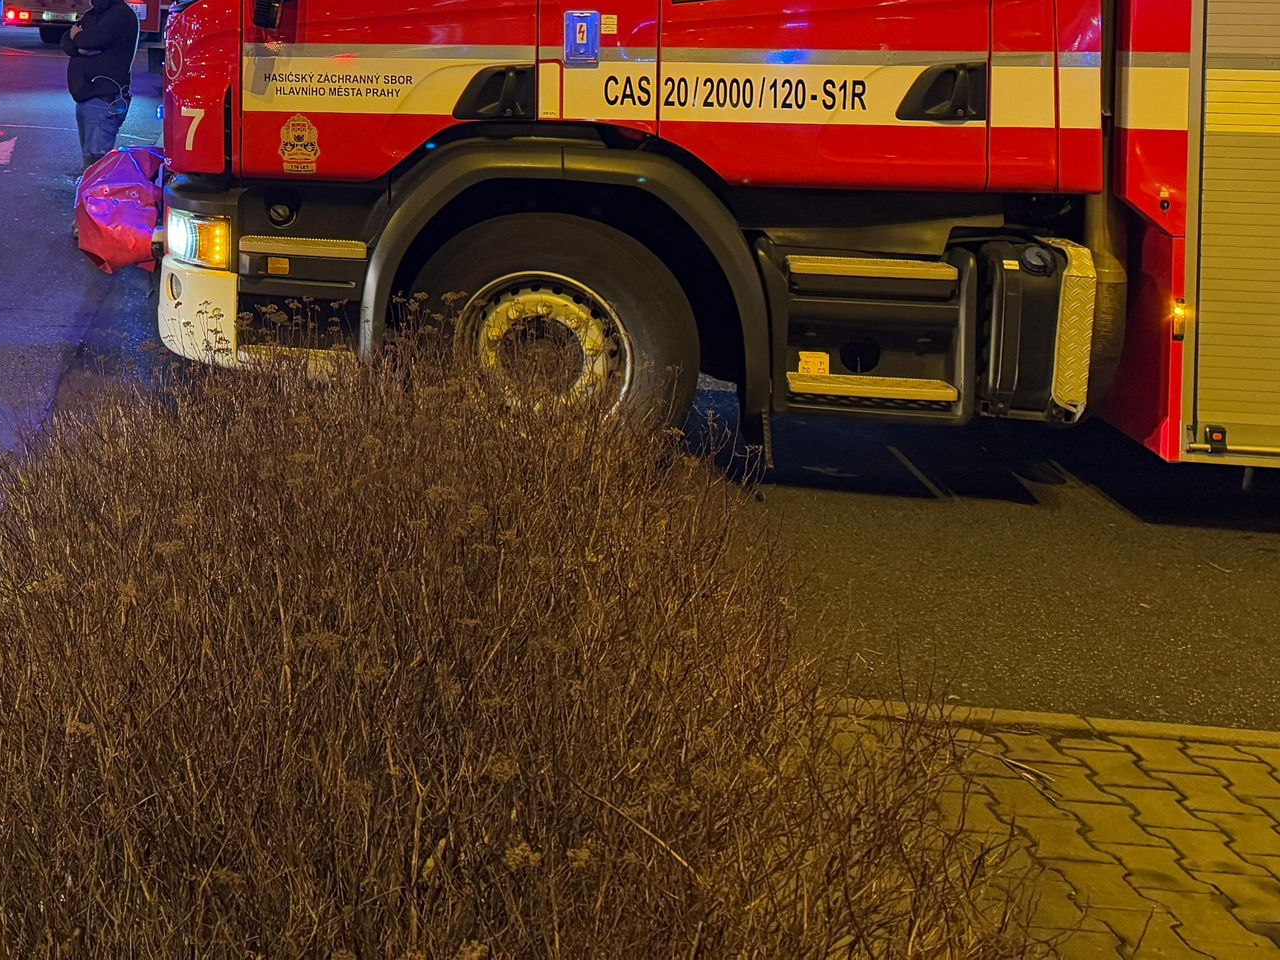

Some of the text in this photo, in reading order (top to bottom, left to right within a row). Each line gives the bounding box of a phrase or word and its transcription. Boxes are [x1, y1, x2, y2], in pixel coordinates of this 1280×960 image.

[264, 72, 413, 85] HASIČSKÝ ZÁCHRANNÝ SBOR
[275, 85, 401, 98] HLAVNÍHO MĚSTA PRAHY
[604, 75, 651, 107] CAS
[181, 108, 205, 151] 7
